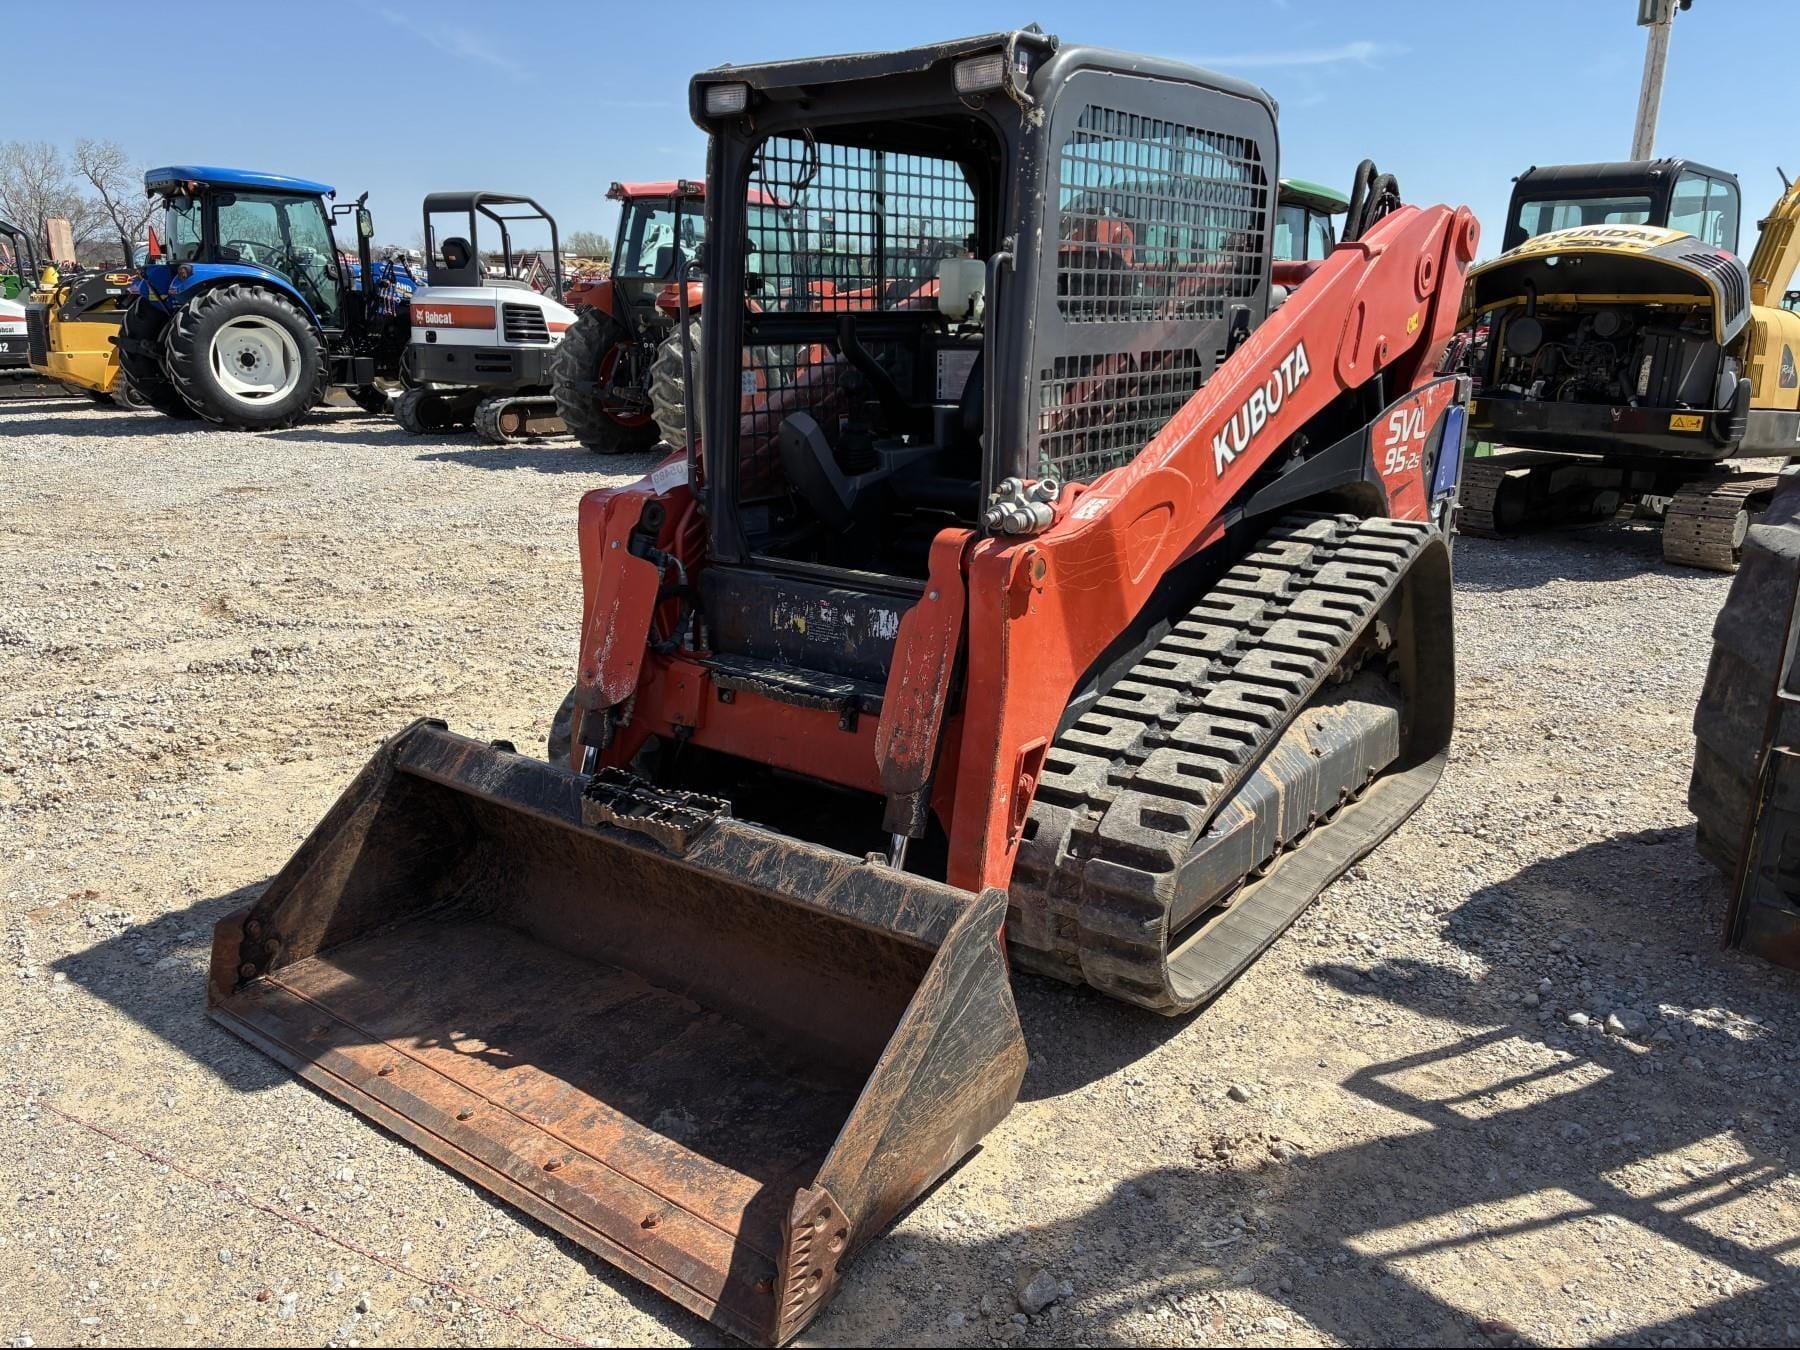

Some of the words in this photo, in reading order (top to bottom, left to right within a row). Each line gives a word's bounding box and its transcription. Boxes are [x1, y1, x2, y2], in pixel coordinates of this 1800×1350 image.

[425, 311, 452, 324] Bobcat
[1212, 339, 1311, 478] KUBOTA
[1385, 407, 1425, 446] SVL
